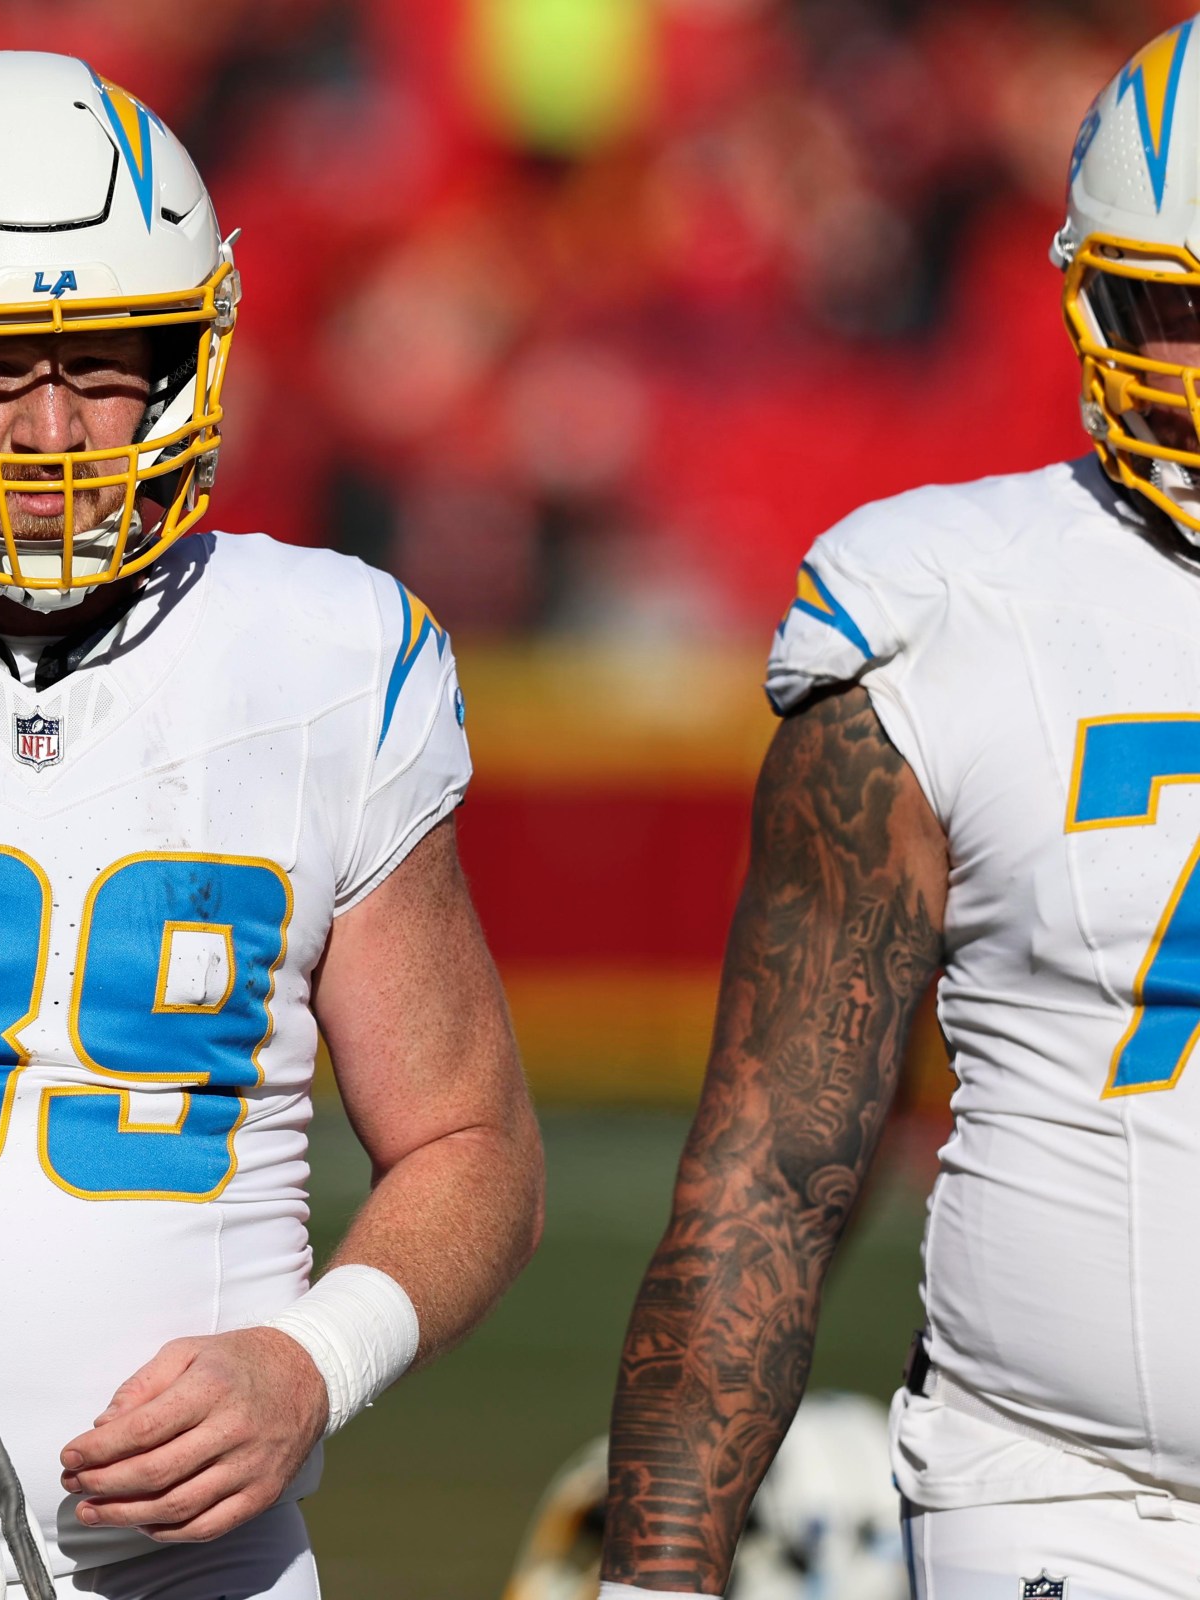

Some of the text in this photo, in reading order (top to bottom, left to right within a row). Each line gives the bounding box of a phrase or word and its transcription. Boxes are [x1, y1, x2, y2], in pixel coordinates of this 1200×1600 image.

[33, 270, 77, 300] LA
[21, 735, 56, 759] NFL
[796, 894, 888, 1147] JAMES
